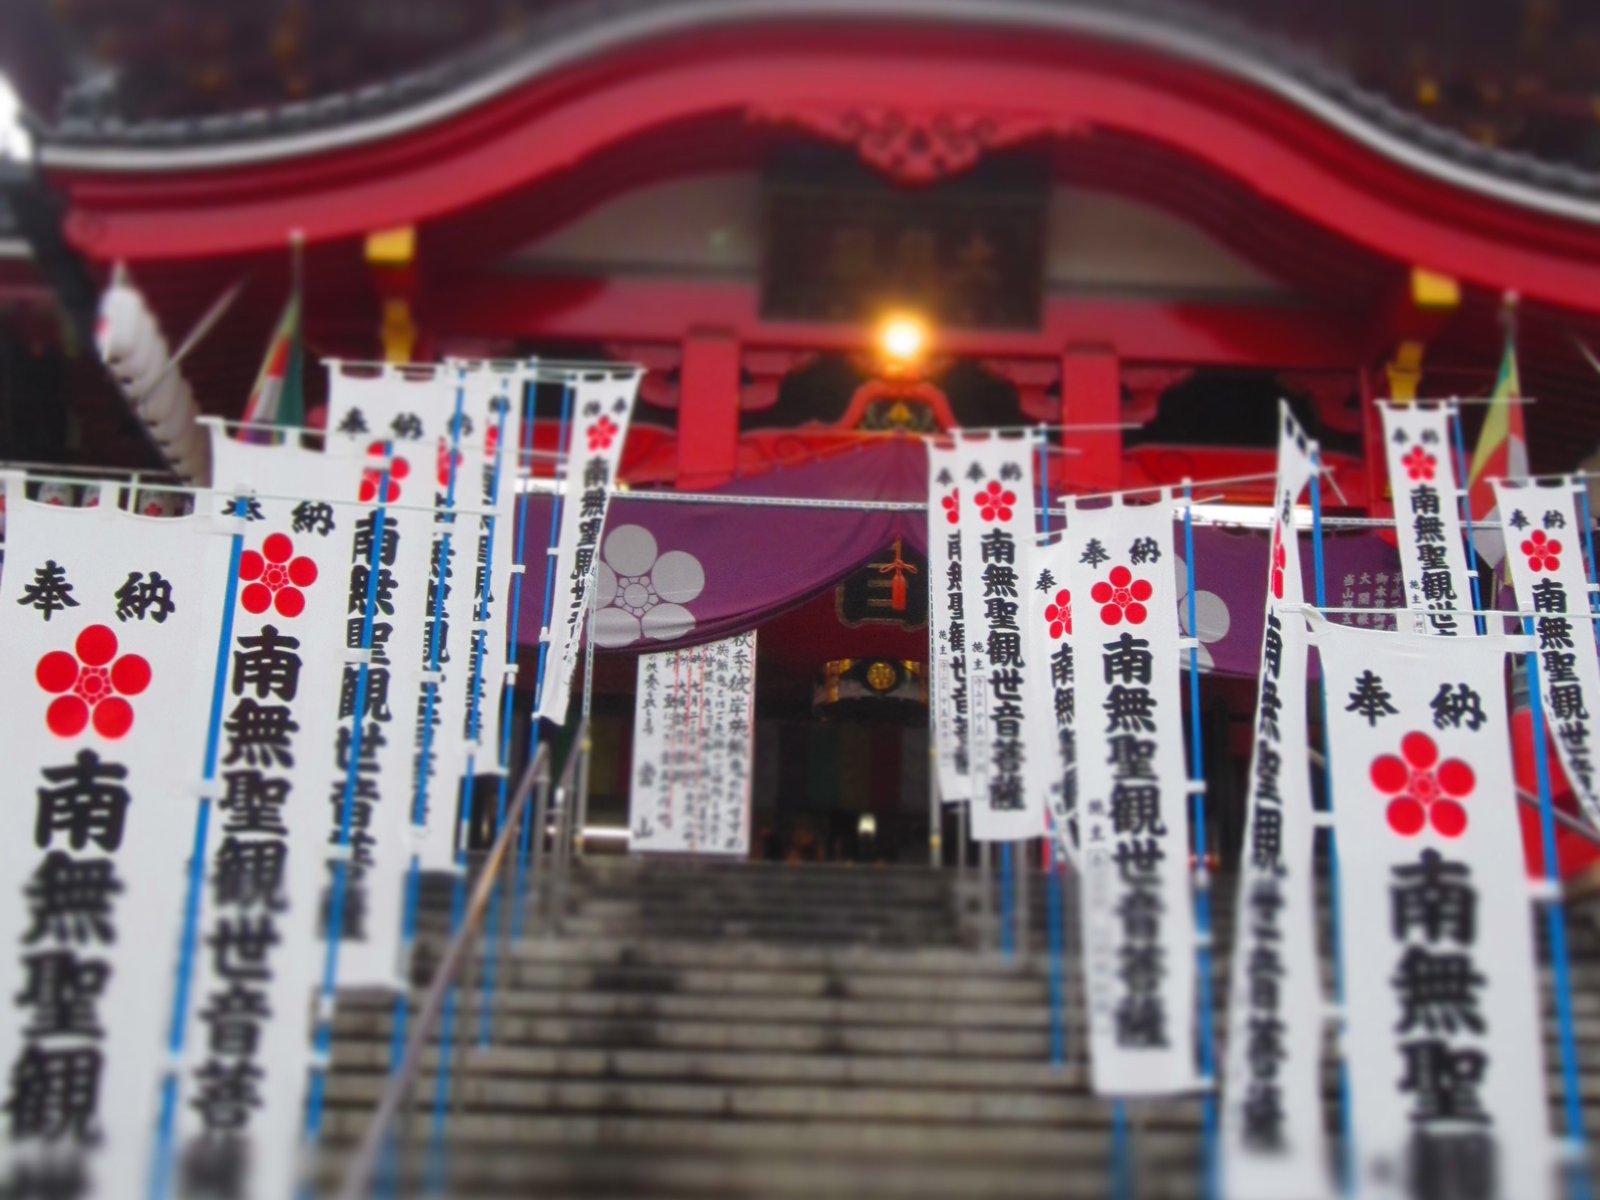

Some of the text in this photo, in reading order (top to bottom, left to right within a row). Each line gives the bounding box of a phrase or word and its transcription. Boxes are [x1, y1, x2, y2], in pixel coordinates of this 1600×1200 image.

[338, 407, 424, 440] 奉納
[936, 467, 954, 487] 奉
[965, 461, 1023, 482] 奉納
[1508, 508, 1567, 532] 奉納
[1079, 536, 1162, 569] 奉納
[1410, 484, 1458, 635] 南無聖観世
[17, 560, 176, 623] 奉納
[1035, 568, 1057, 593] 奉
[971, 641, 986, 671] 施主
[1346, 670, 1487, 731] 奉納
[187, 624, 303, 1200] 南無聖観世音菩
[2, 748, 132, 1200] 南無聖観
